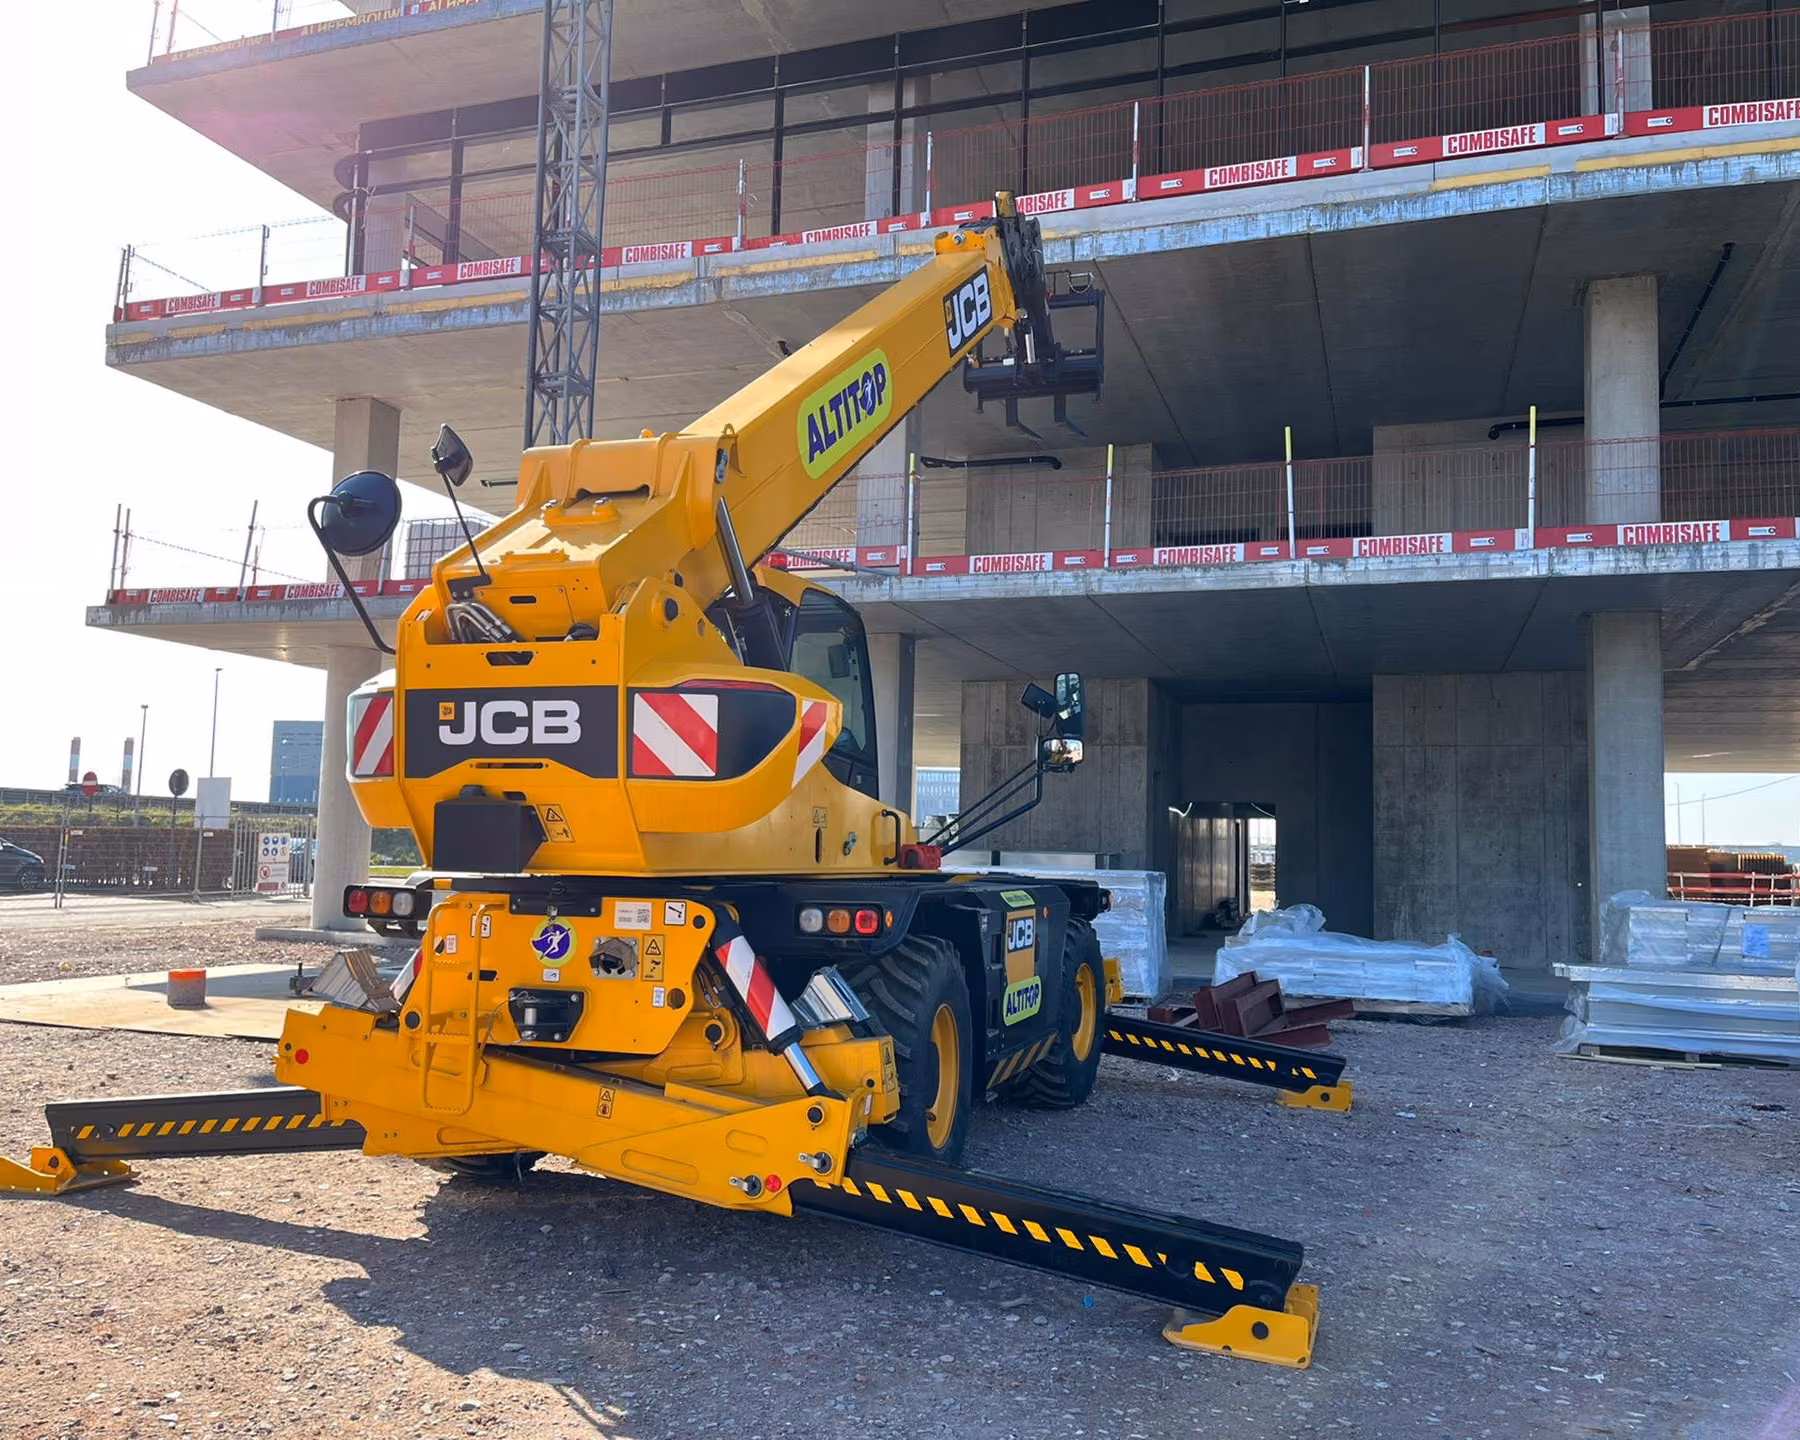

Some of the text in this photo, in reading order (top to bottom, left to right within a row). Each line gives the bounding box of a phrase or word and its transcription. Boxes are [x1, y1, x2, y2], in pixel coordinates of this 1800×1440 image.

[1448, 126, 1536, 154] COMBISAFE
[1209, 159, 1288, 186] COMBISAFE
[1016, 192, 1067, 214] MBISAFE
[806, 224, 870, 243] COMBISAFE
[625, 243, 686, 263] COMBISAFE
[460, 260, 516, 278] COMBISAFE
[309, 278, 361, 296] COMBISAFE
[168, 294, 217, 312] COMBISAFE
[948, 273, 992, 349] JCB
[807, 362, 887, 464] ALTITOP
[1623, 523, 1720, 545] COMBISAFE
[1158, 545, 1236, 565] COMBISAFE
[1358, 535, 1443, 557] COMBISAFE
[973, 554, 1046, 573] COMBISAFE
[151, 590, 199, 603] COMBISAFE
[287, 584, 340, 598] COMBISAFE
[439, 700, 582, 745] JCB
[1008, 919, 1033, 950] JCB
[1006, 984, 1039, 1017] ALTITOP
